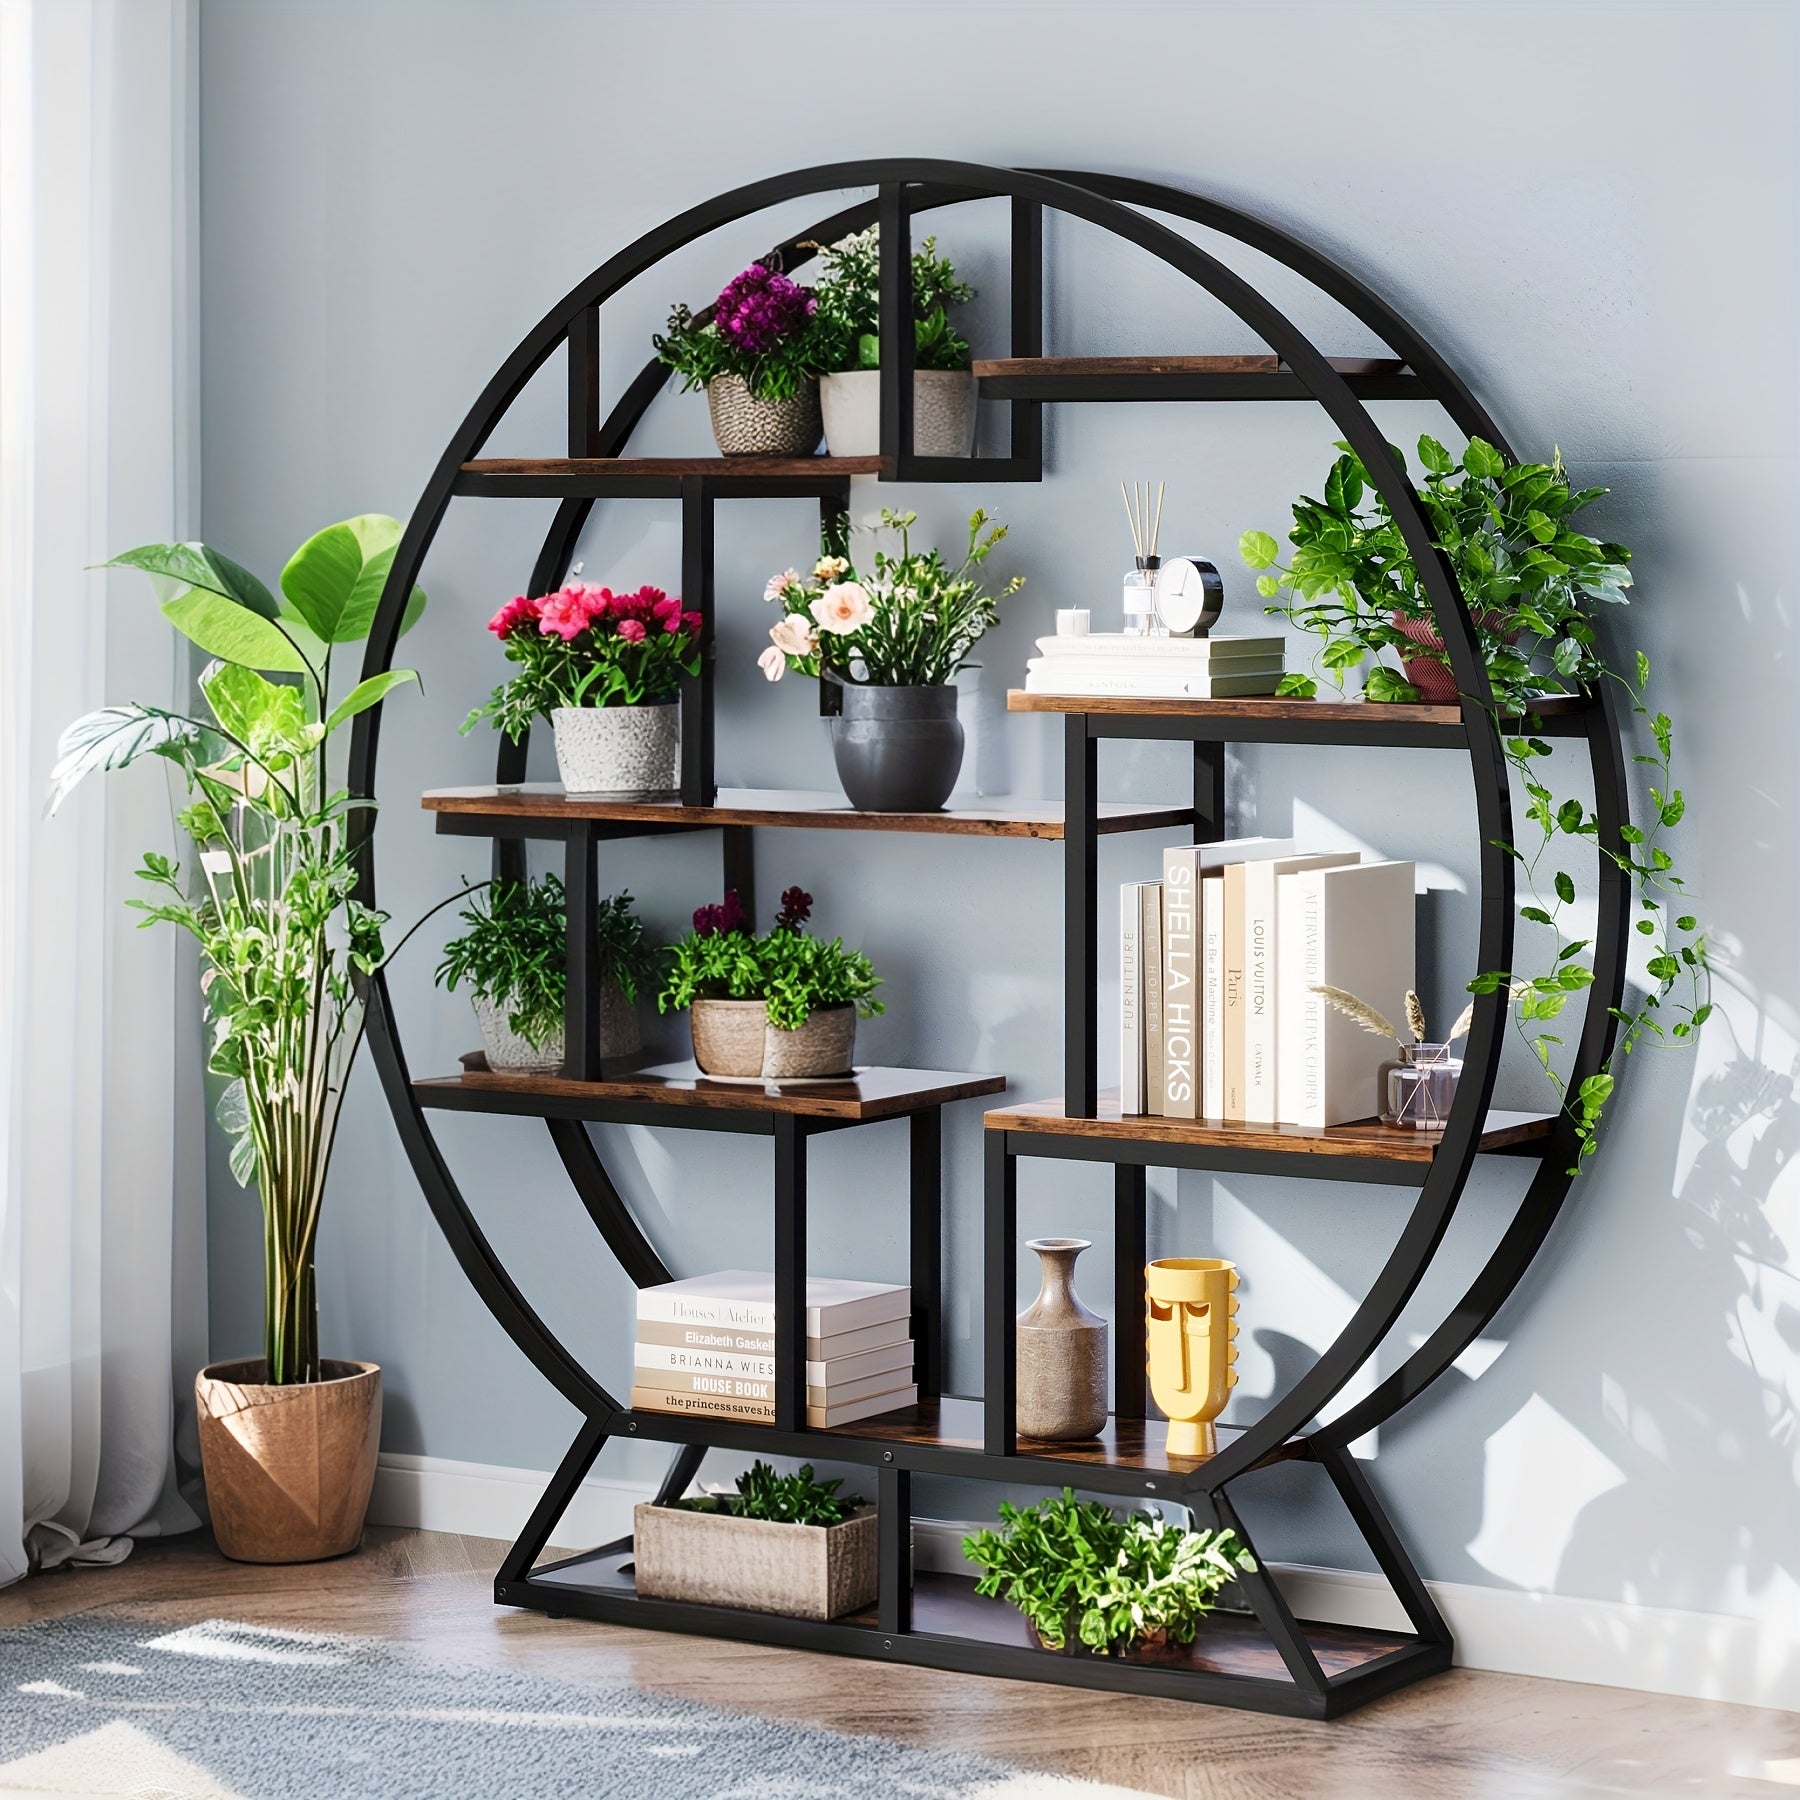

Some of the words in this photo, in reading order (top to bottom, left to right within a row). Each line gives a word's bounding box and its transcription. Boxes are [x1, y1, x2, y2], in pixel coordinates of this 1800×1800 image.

[1146, 903, 1154, 952] KELLY
[1208, 935, 1216, 946] To
[1254, 920, 1264, 957] LOUIS
[1305, 890, 1318, 975] AFTERWORD
[1124, 932, 1134, 1029] FURNITURE
[1208, 949, 1216, 965] Be
[1148, 965, 1157, 1032] HOPPEN
[1208, 978, 1216, 1025] Machine
[1228, 969, 1242, 1007] Paris
[1254, 961, 1264, 1015] VUITTON
[1305, 1001, 1317, 1055] DEEPAK
[1150, 1043, 1159, 1090] STYLE
[1168, 1004, 1190, 1102] HICKS
[1305, 1056, 1318, 1110] CHOPRA
[672, 1301, 714, 1320] Houses
[728, 1308, 766, 1324] Atelier
[670, 1354, 734, 1371] BRIANNA
[741, 1362, 774, 1374] WIES
[686, 1332, 732, 1347] Elizabeth
[736, 1336, 774, 1351] Gaskell
[666, 1395, 684, 1406] the
[686, 1398, 731, 1412] princess
[732, 1403, 762, 1416] saves
[693, 1377, 732, 1393] HOUSE
[736, 1381, 768, 1398] BOOK
